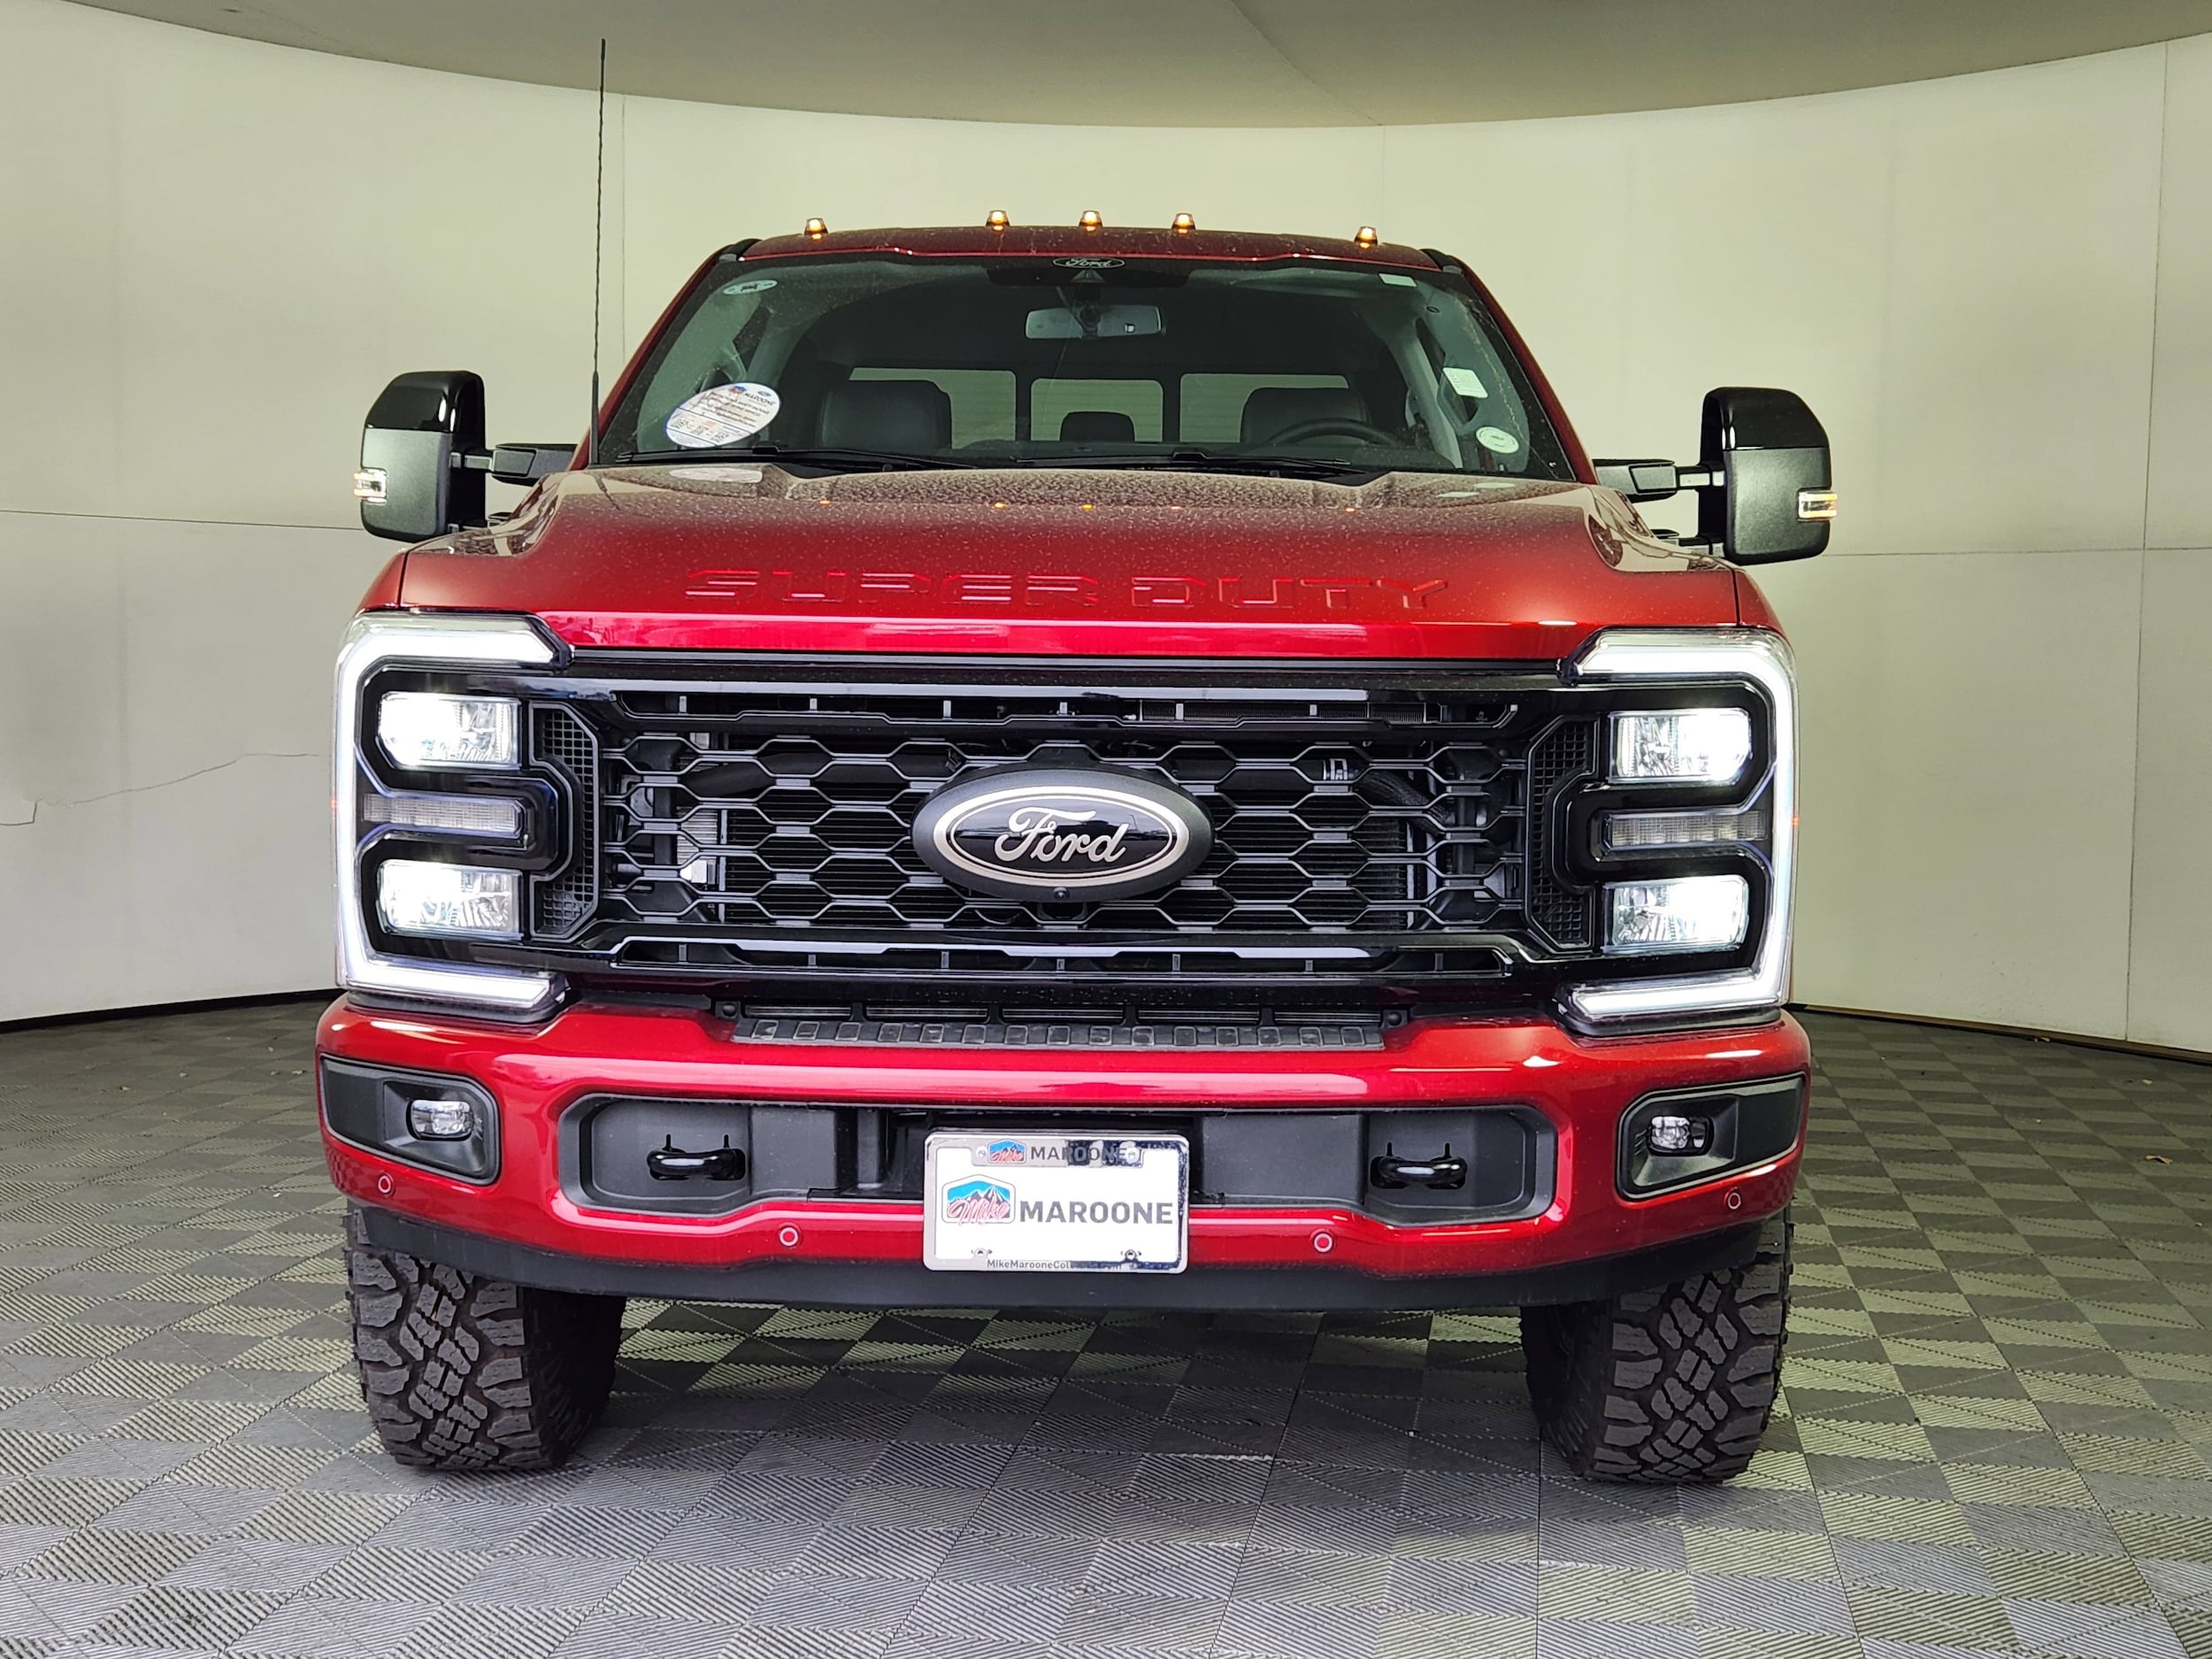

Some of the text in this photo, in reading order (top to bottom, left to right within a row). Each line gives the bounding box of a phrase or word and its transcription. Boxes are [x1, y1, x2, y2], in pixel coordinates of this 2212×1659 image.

[1065, 257, 1112, 267] Ford
[685, 570, 1448, 610] SUPER DUTY
[994, 806, 1130, 862] Ford
[1031, 1146, 1128, 1161] MAROONE
[947, 1196, 1174, 1227] Mike MAROONE
